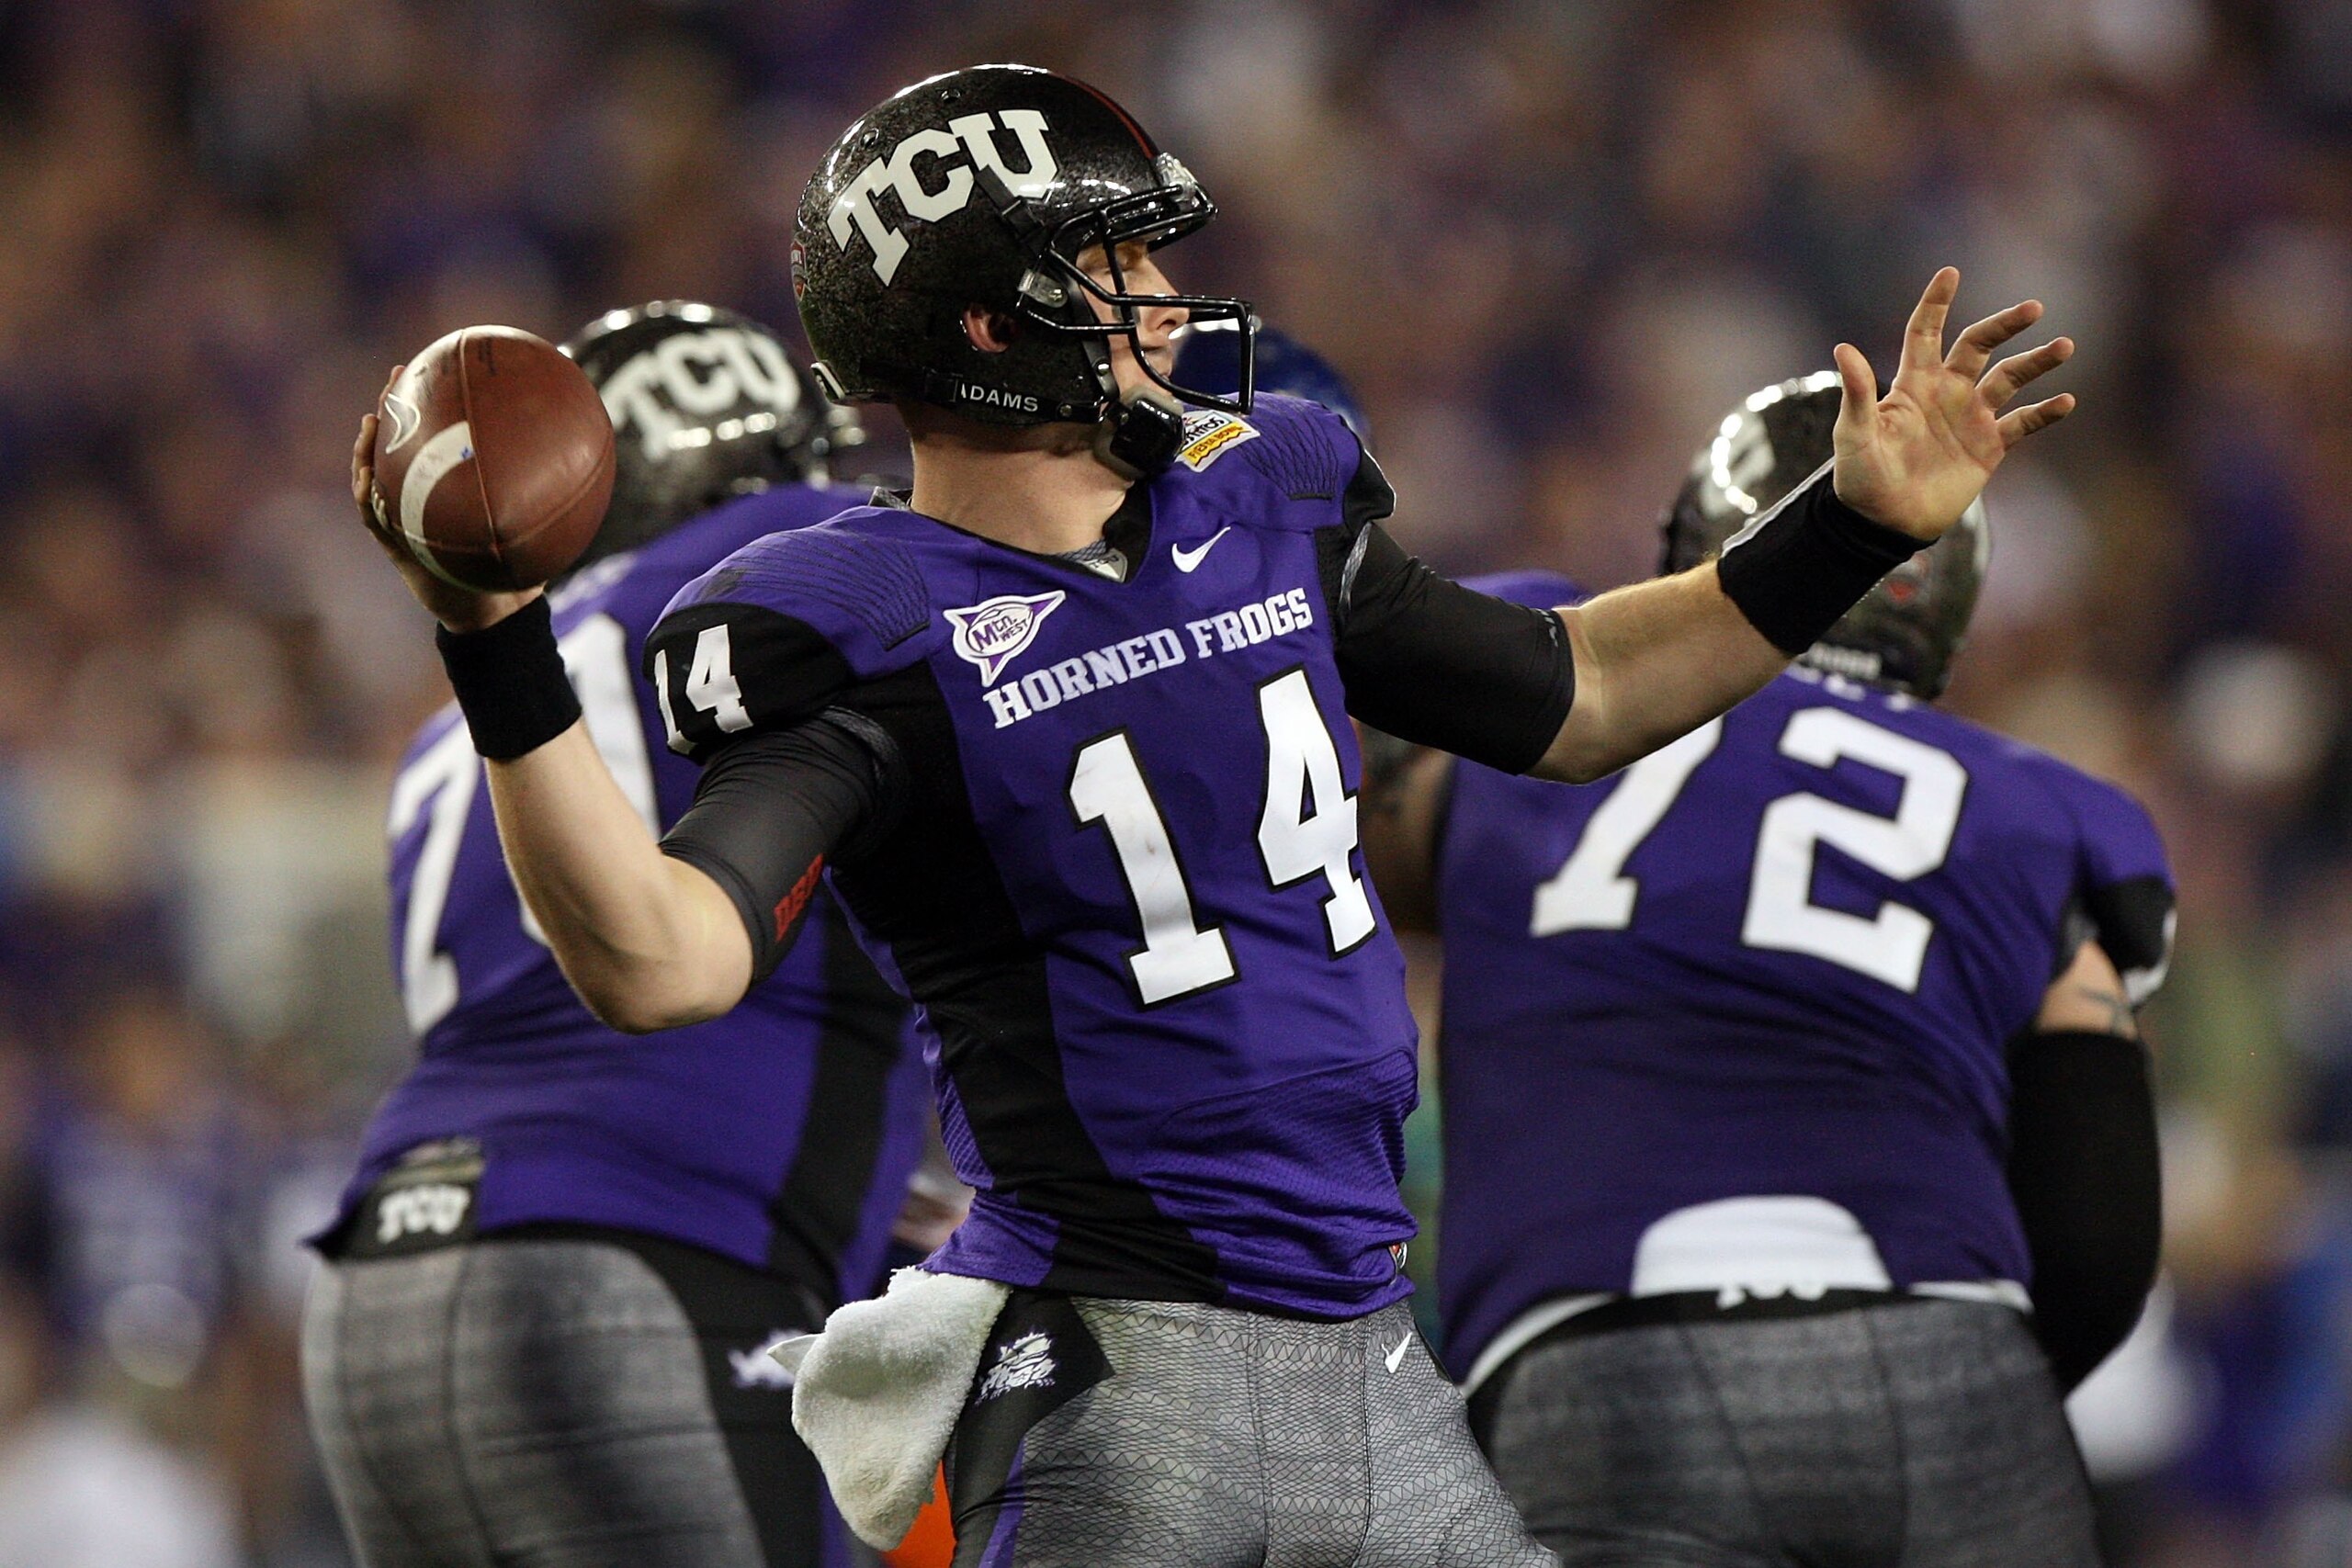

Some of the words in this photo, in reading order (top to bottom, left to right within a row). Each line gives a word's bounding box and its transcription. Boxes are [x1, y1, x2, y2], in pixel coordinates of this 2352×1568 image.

[826, 109, 1059, 288] TCU
[599, 328, 799, 459] TCU
[1187, 436, 1217, 458] FIESTA
[653, 623, 754, 755] 14
[982, 627, 1186, 729] HORNED
[1186, 588, 1314, 660] FROGS
[1000, 619, 1029, 643] WEST
[1068, 668, 1376, 1005] 14
